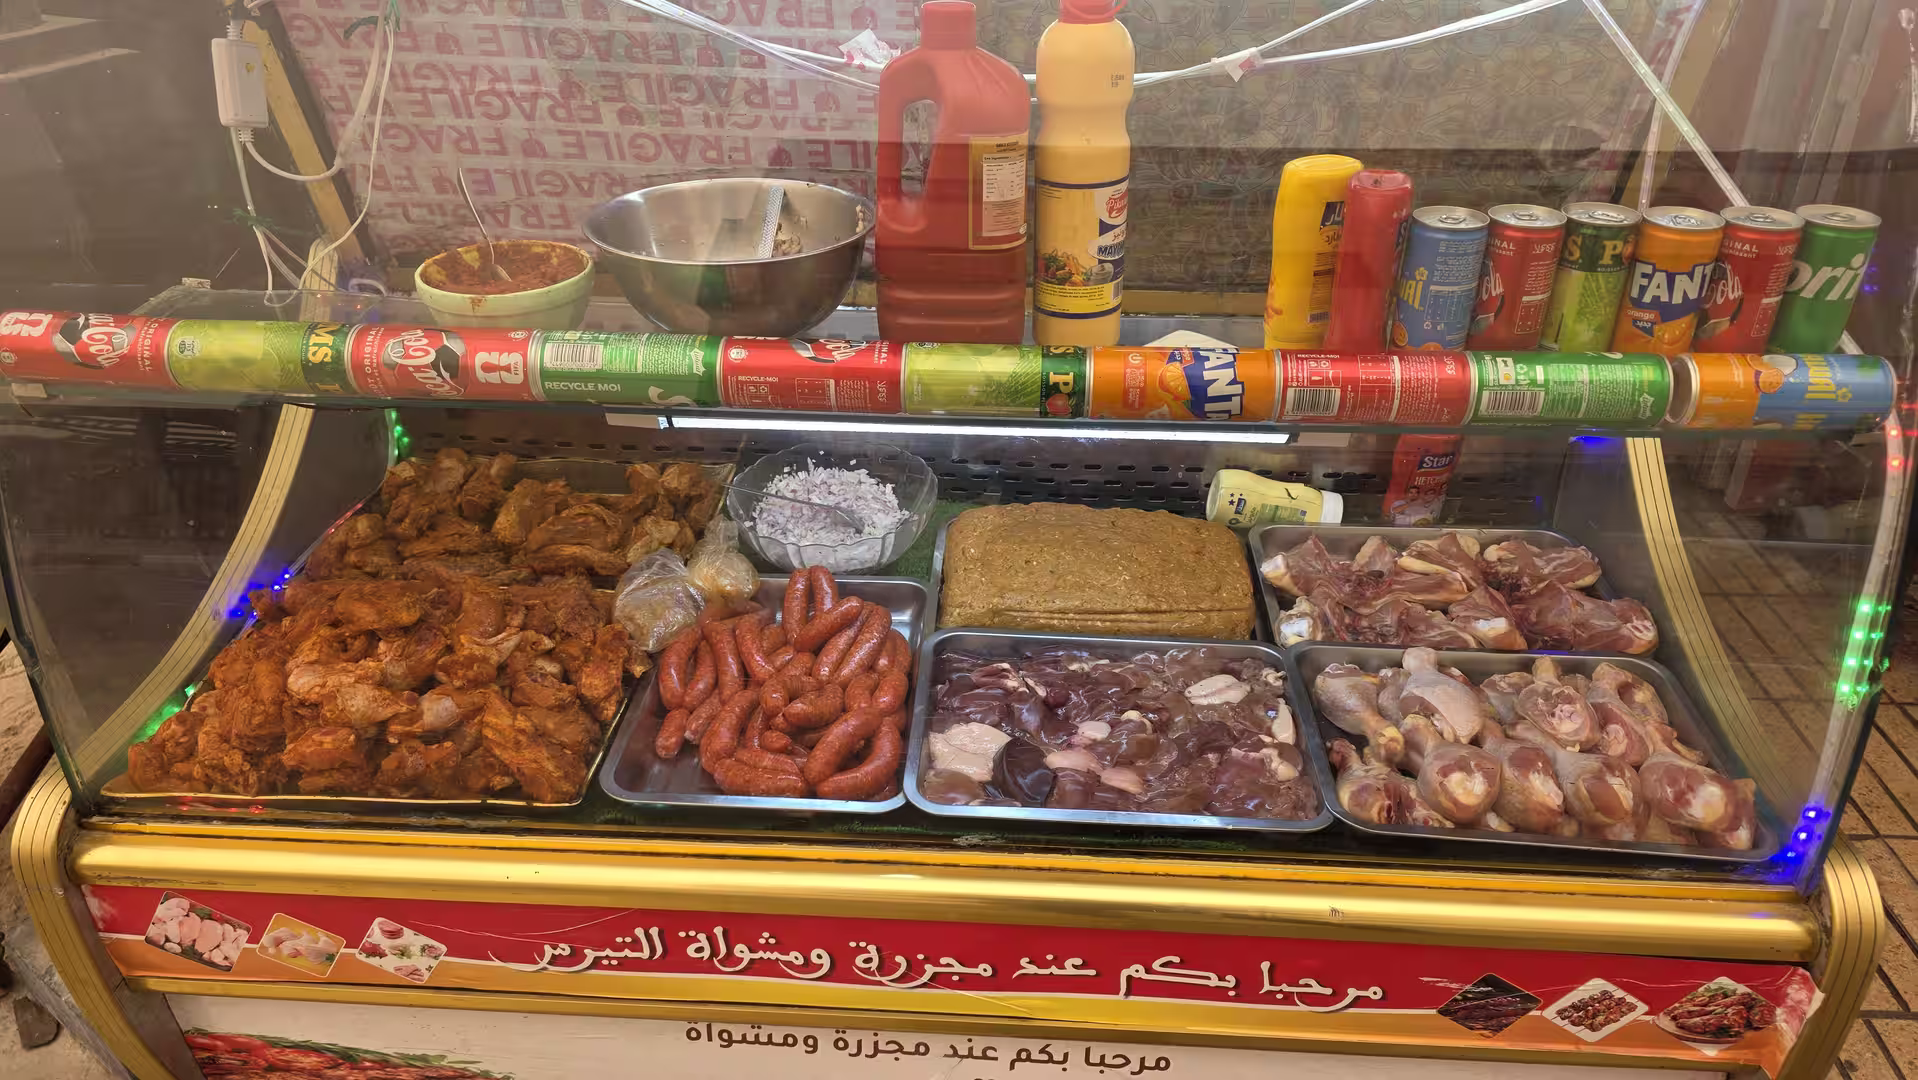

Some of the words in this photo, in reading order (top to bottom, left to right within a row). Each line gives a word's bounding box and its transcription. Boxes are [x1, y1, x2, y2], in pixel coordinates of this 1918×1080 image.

[594, 71, 799, 112] FRAGILE
[555, 129, 753, 166] FRAGILE
[364, 327, 380, 374] ORIGINAL
[544, 381, 596, 391] RECYCLE
[597, 383, 622, 392] MOI
[1422, 455, 1450, 469] Star
[488, 926, 663, 972] التيرس
[678, 926, 832, 979] ومشواة
[849, 941, 994, 988] مجزرة
[1012, 953, 1097, 979] عند
[1119, 955, 1237, 999] بكم
[1260, 960, 1384, 1013] مرحبا
[685, 1021, 820, 1054] ومشواة
[832, 1029, 931, 1061] مجزرة
[942, 1037, 999, 1062] عند
[1009, 1044, 1070, 1072] بكم
[1083, 1045, 1171, 1076] مرحبا
